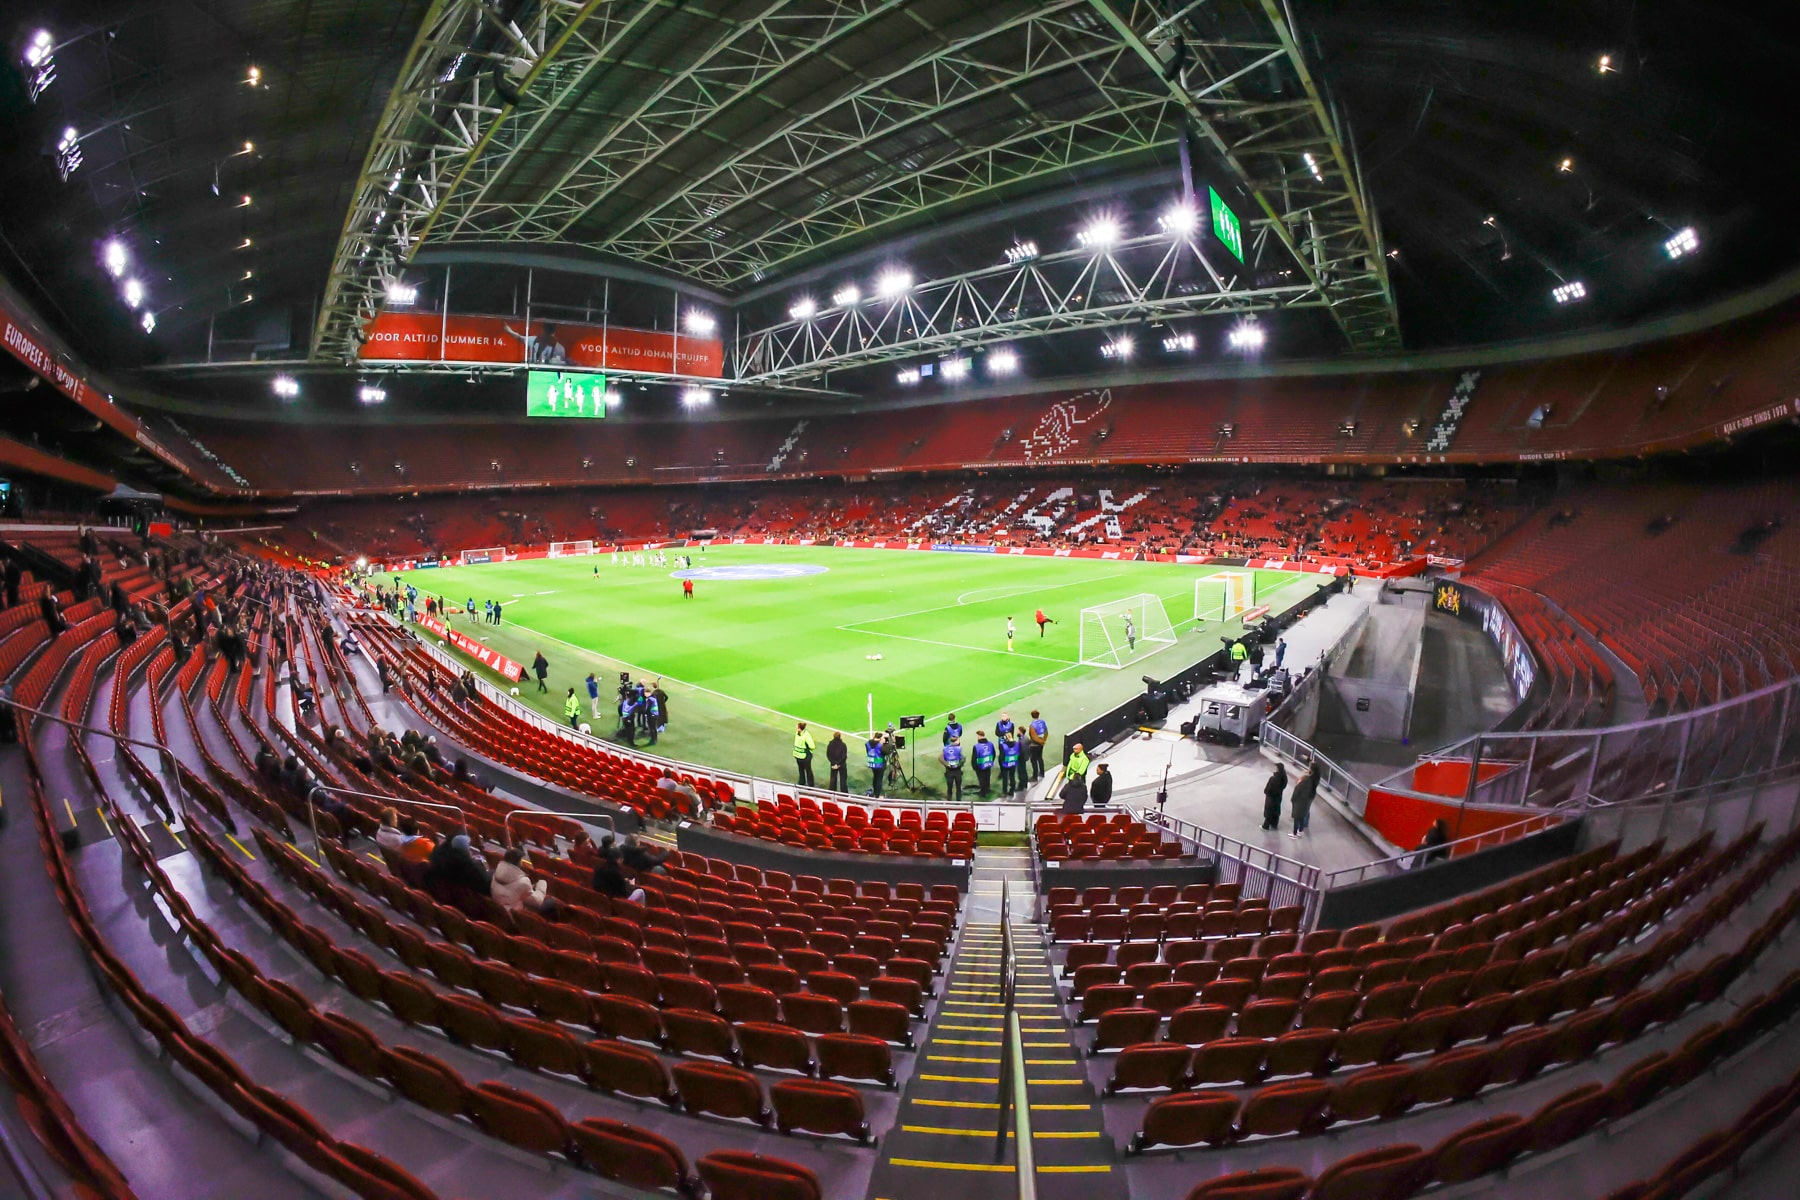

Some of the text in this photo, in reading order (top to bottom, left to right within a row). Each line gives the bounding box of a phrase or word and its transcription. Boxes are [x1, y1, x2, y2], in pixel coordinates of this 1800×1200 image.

[4, 323, 43, 367] EUROPESE
[368, 332, 400, 342] VOOR
[403, 333, 439, 343] ALTIJD
[443, 335, 489, 345] NUMMER
[611, 346, 640, 356] ALTIJD
[643, 349, 673, 359] JOHAN
[675, 352, 709, 362] CRUIJFF
